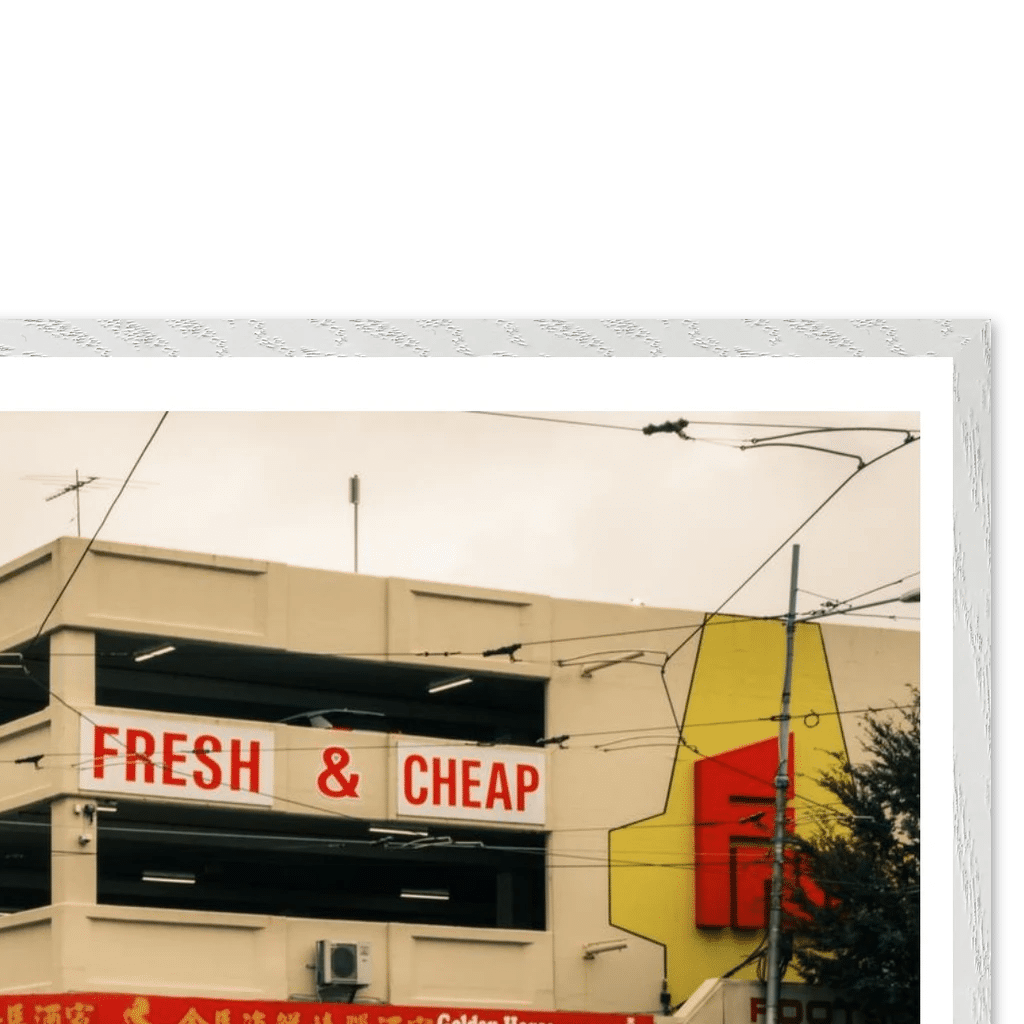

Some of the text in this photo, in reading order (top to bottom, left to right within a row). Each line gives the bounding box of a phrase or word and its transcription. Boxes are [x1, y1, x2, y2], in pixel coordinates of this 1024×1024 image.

[93, 726, 540, 812] FRESH & CHEAP
